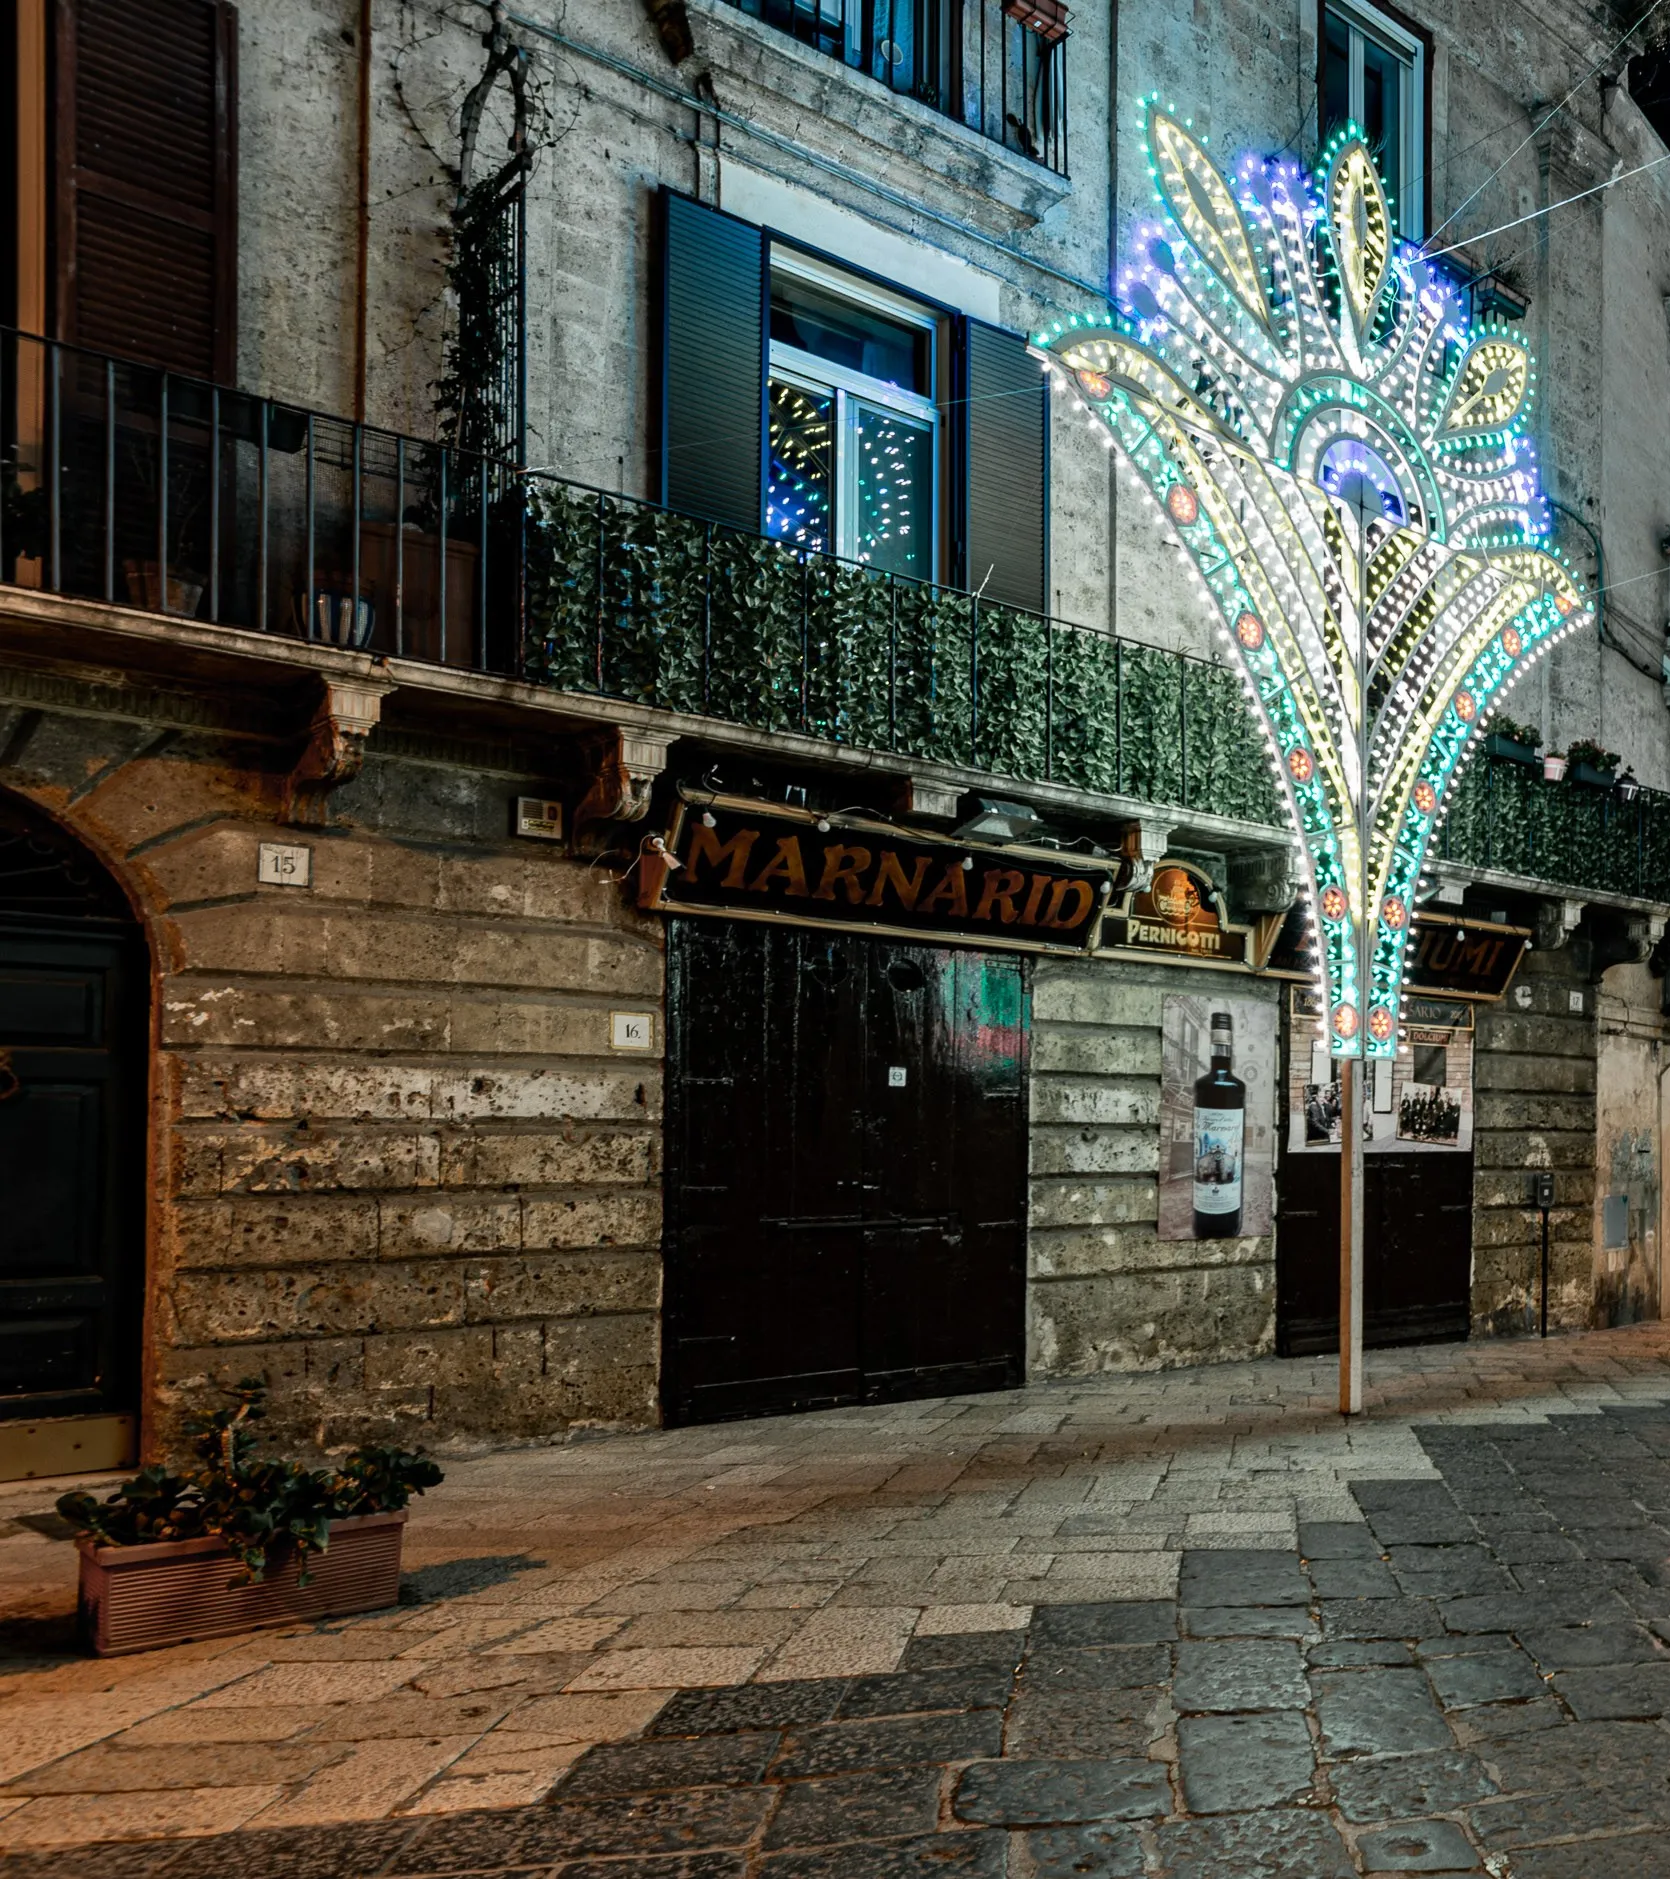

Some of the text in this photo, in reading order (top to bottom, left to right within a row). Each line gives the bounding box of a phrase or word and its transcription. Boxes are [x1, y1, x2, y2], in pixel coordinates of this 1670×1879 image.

[270, 855, 296, 875] 15
[676, 822, 1096, 930] MARNARID
[1127, 919, 1220, 950] PERNIGOTTI
